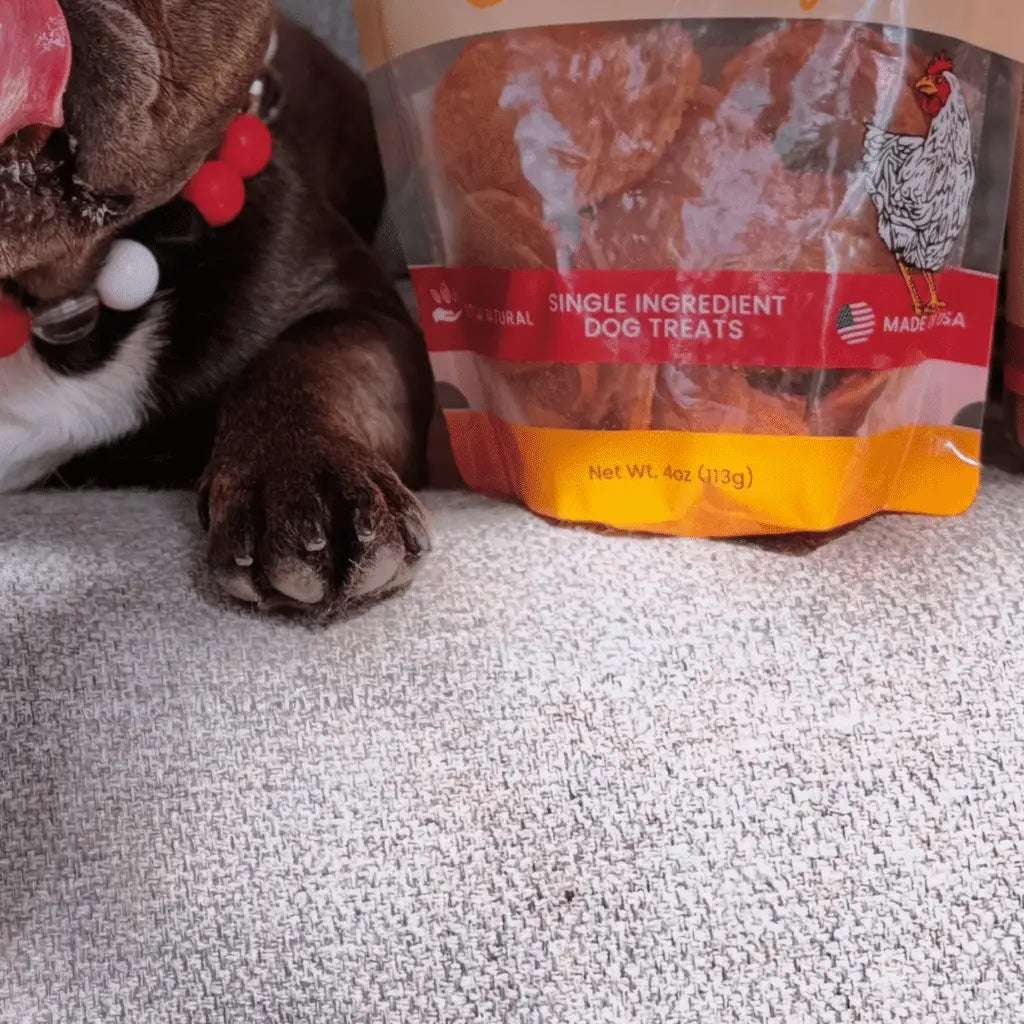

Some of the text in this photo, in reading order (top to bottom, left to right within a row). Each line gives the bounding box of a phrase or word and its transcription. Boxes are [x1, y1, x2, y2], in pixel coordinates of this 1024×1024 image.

[548, 292, 786, 316] SINGLE INGREDIENT
[584, 317, 743, 340] DOG TREATS
[883, 315, 927, 333] MADE
[588, 464, 753, 490] Net Wt. 4oz (113g)
